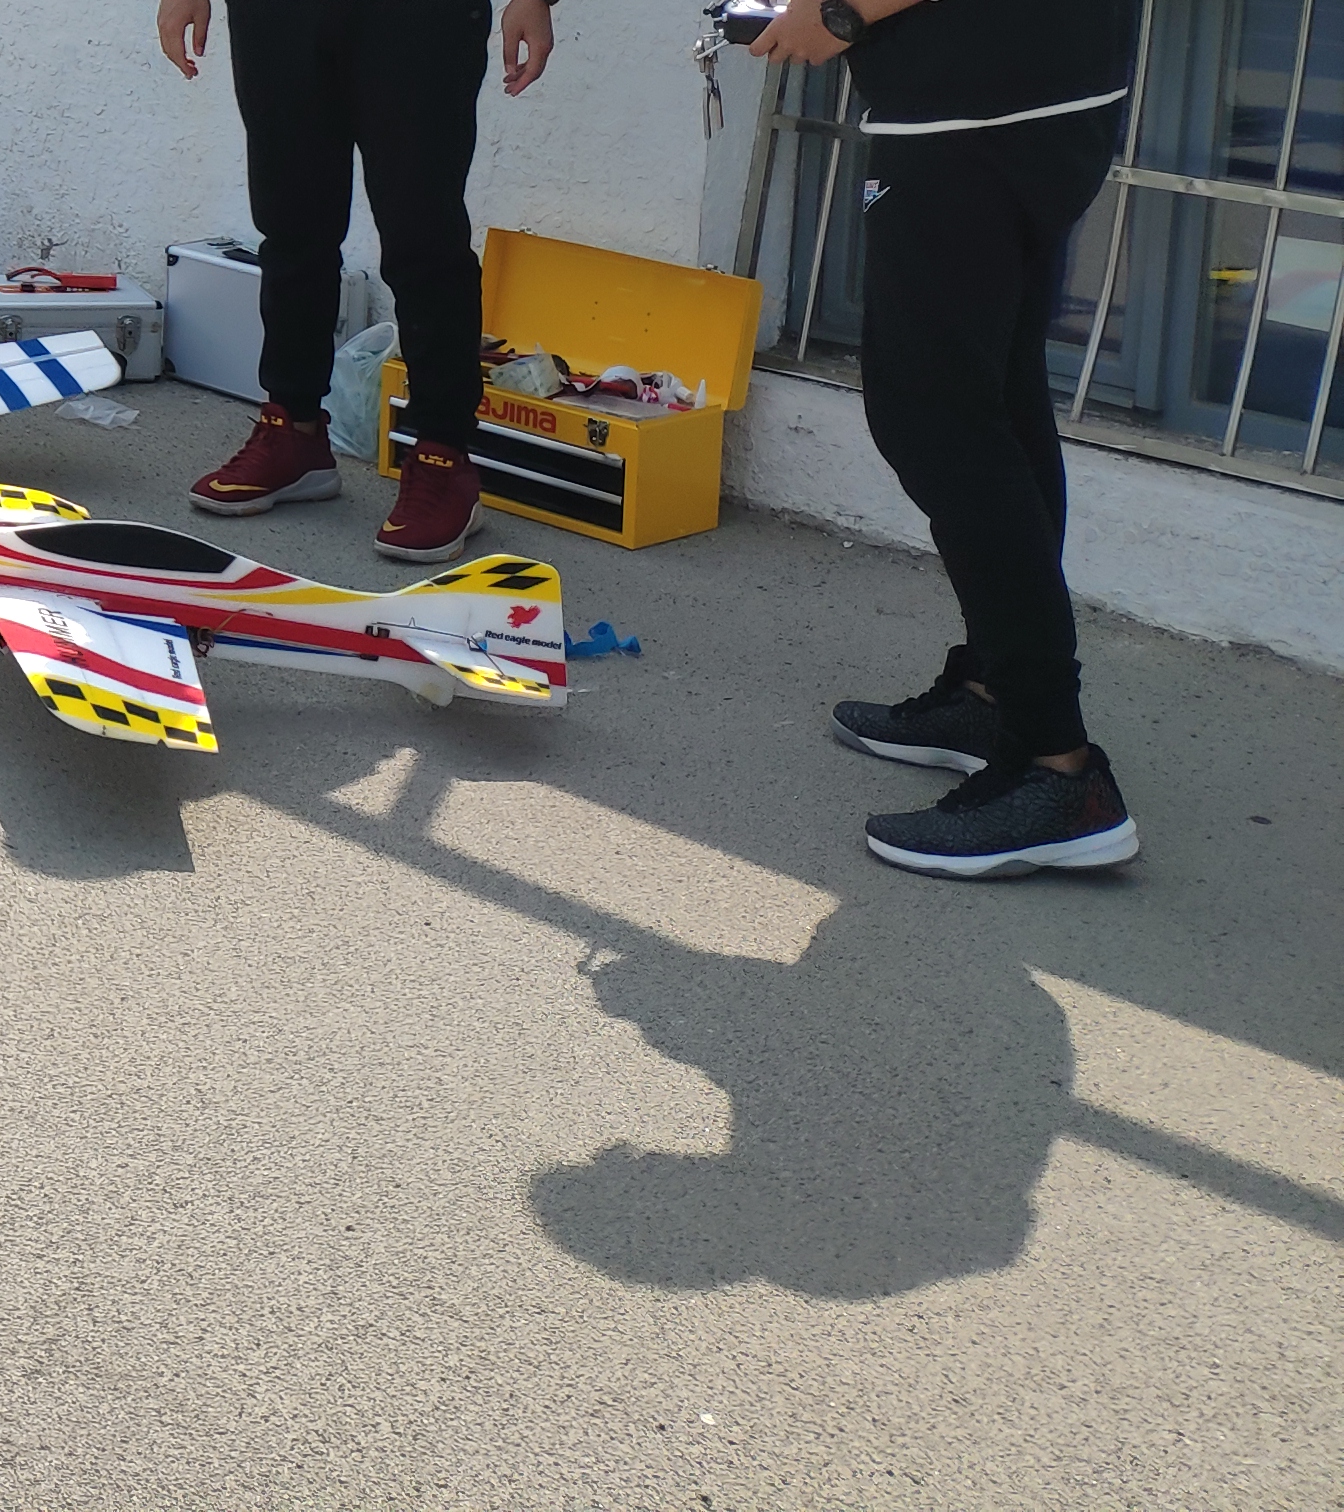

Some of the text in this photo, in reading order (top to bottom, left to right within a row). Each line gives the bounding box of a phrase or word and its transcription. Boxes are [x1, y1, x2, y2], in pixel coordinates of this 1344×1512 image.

[484, 629, 562, 650] Red eagle model
